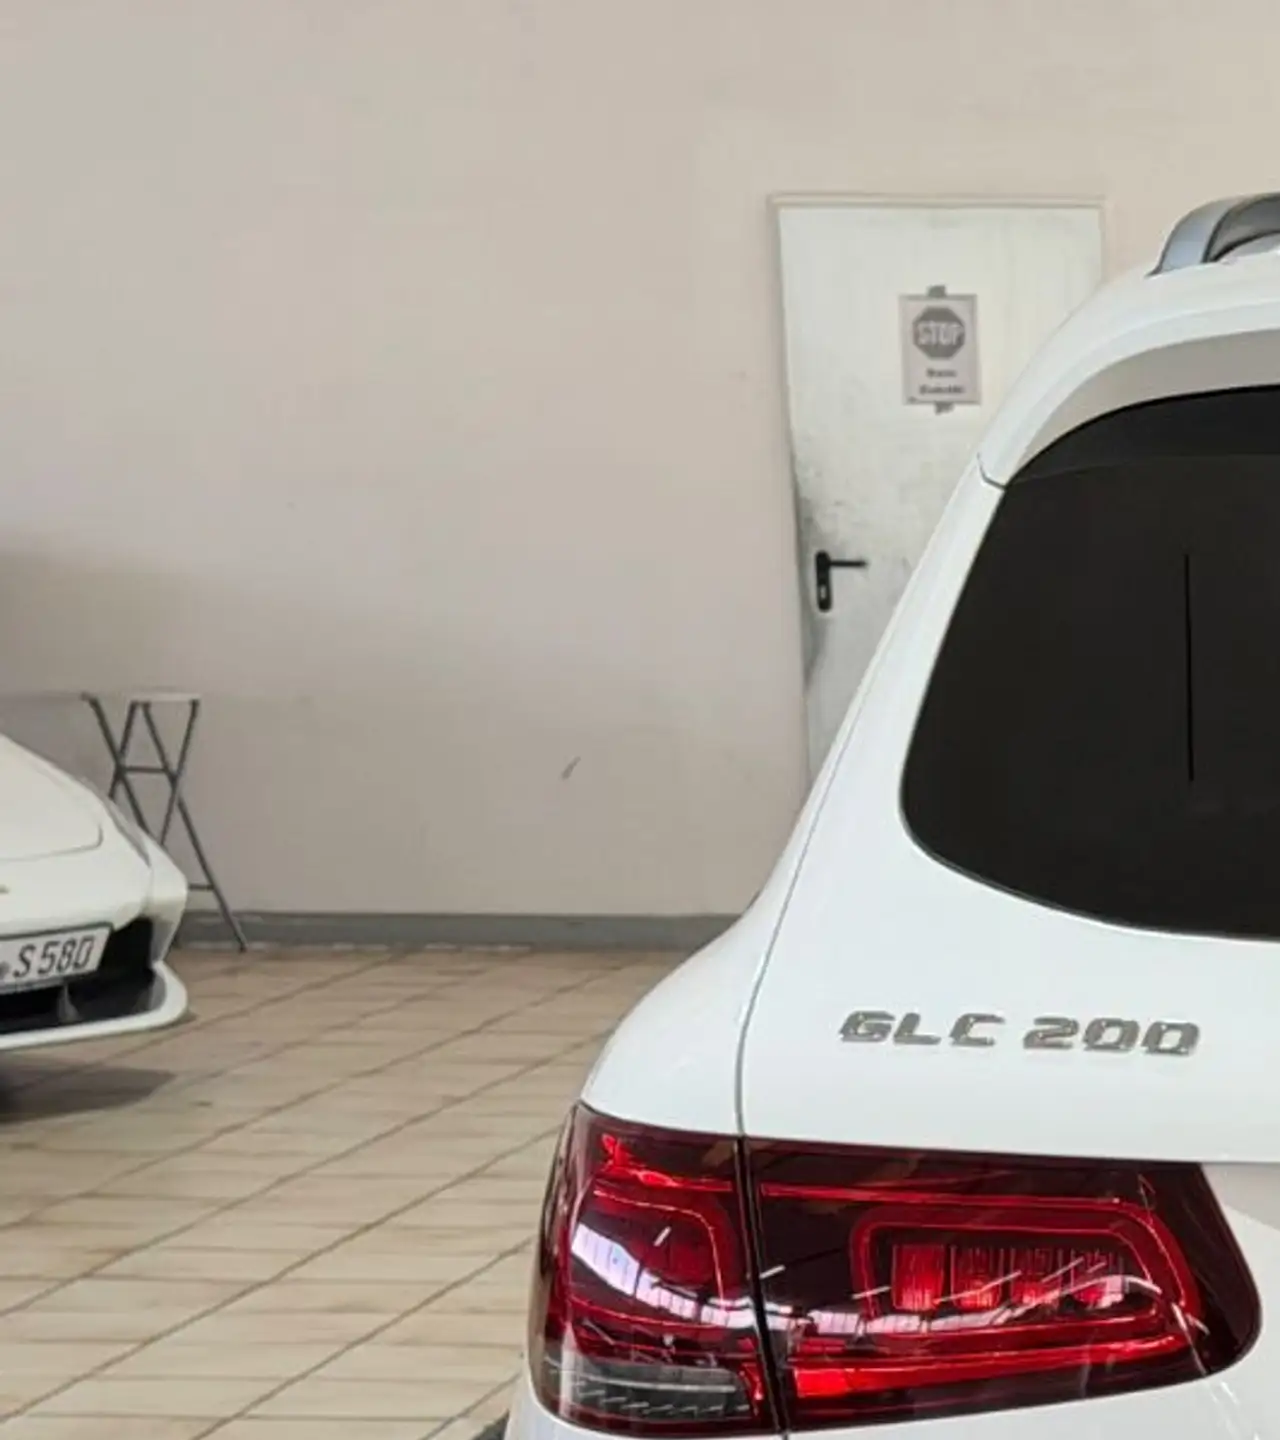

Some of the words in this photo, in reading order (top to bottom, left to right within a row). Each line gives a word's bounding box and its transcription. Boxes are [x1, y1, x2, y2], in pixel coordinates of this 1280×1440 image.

[37, 935, 96, 975] 580
[838, 1009, 1006, 1047] GLC
[1021, 1015, 1202, 1057] 200
